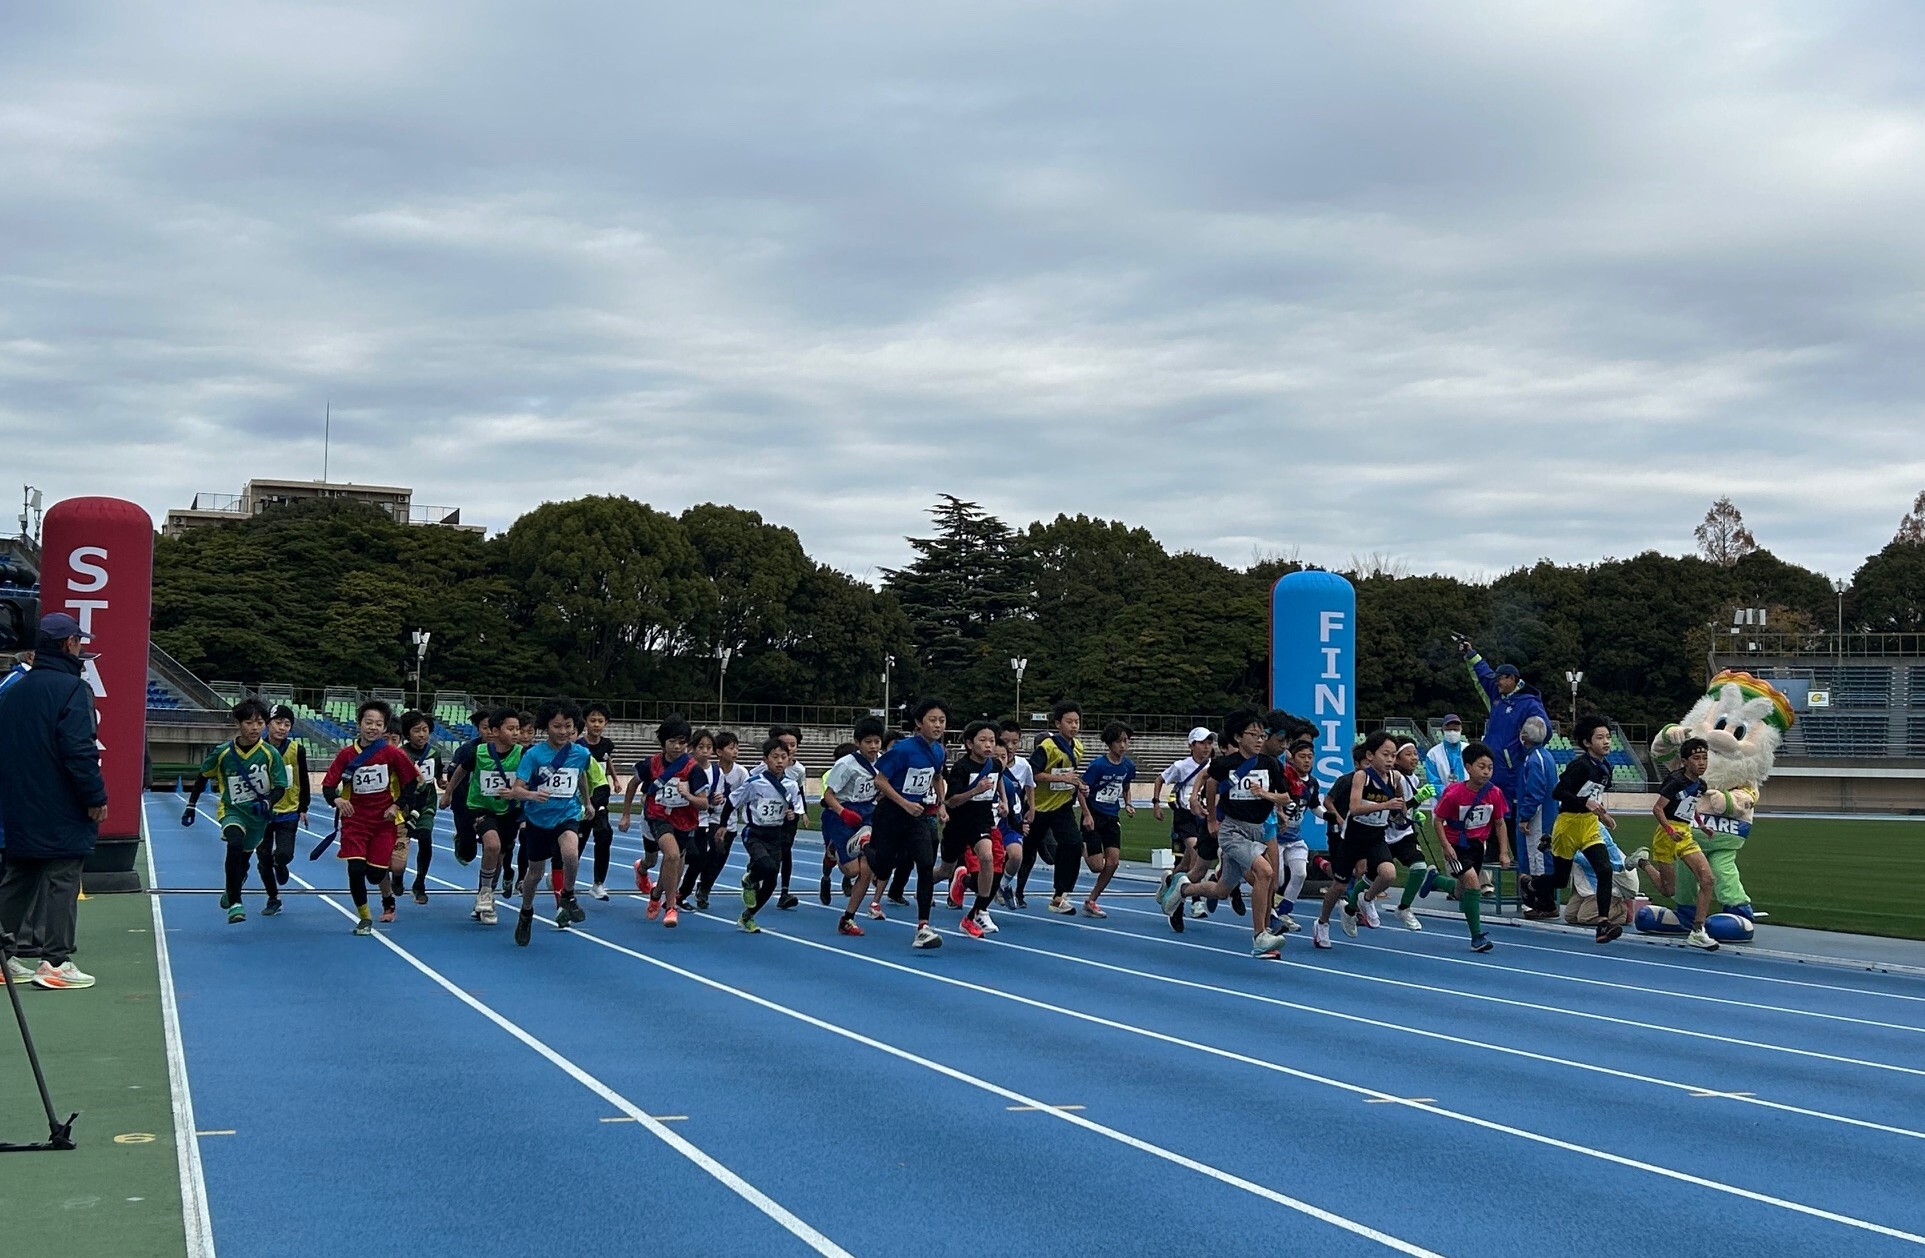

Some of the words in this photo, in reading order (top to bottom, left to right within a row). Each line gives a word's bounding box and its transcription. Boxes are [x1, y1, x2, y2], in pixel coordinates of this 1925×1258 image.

[65, 546, 109, 767] STA
[1314, 611, 1346, 825] FINIS
[355, 772, 383, 786] 34-1
[546, 776, 572, 788] 18-1
[1237, 779, 1263, 791] 101
[234, 779, 264, 794] 351
[662, 787, 684, 799] 13-
[762, 805, 784, 816] 33-1
